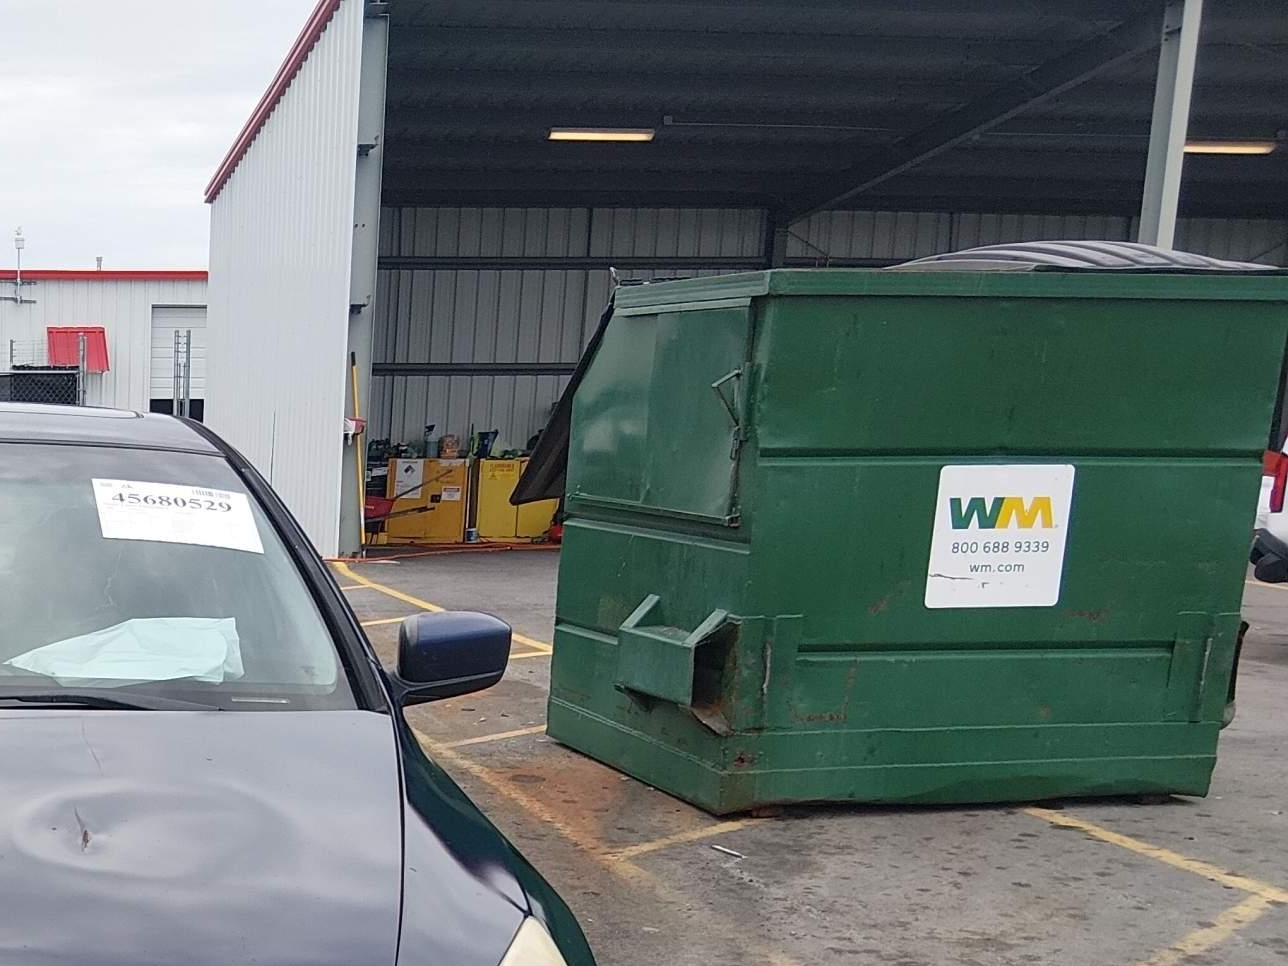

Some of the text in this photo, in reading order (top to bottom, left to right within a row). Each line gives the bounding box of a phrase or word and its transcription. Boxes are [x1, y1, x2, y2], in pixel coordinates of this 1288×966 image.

[112, 492, 232, 512] 45680529
[949, 497, 1053, 529] WM
[951, 541, 1049, 553] 800 688 9339
[969, 563, 1024, 573] wm.com
